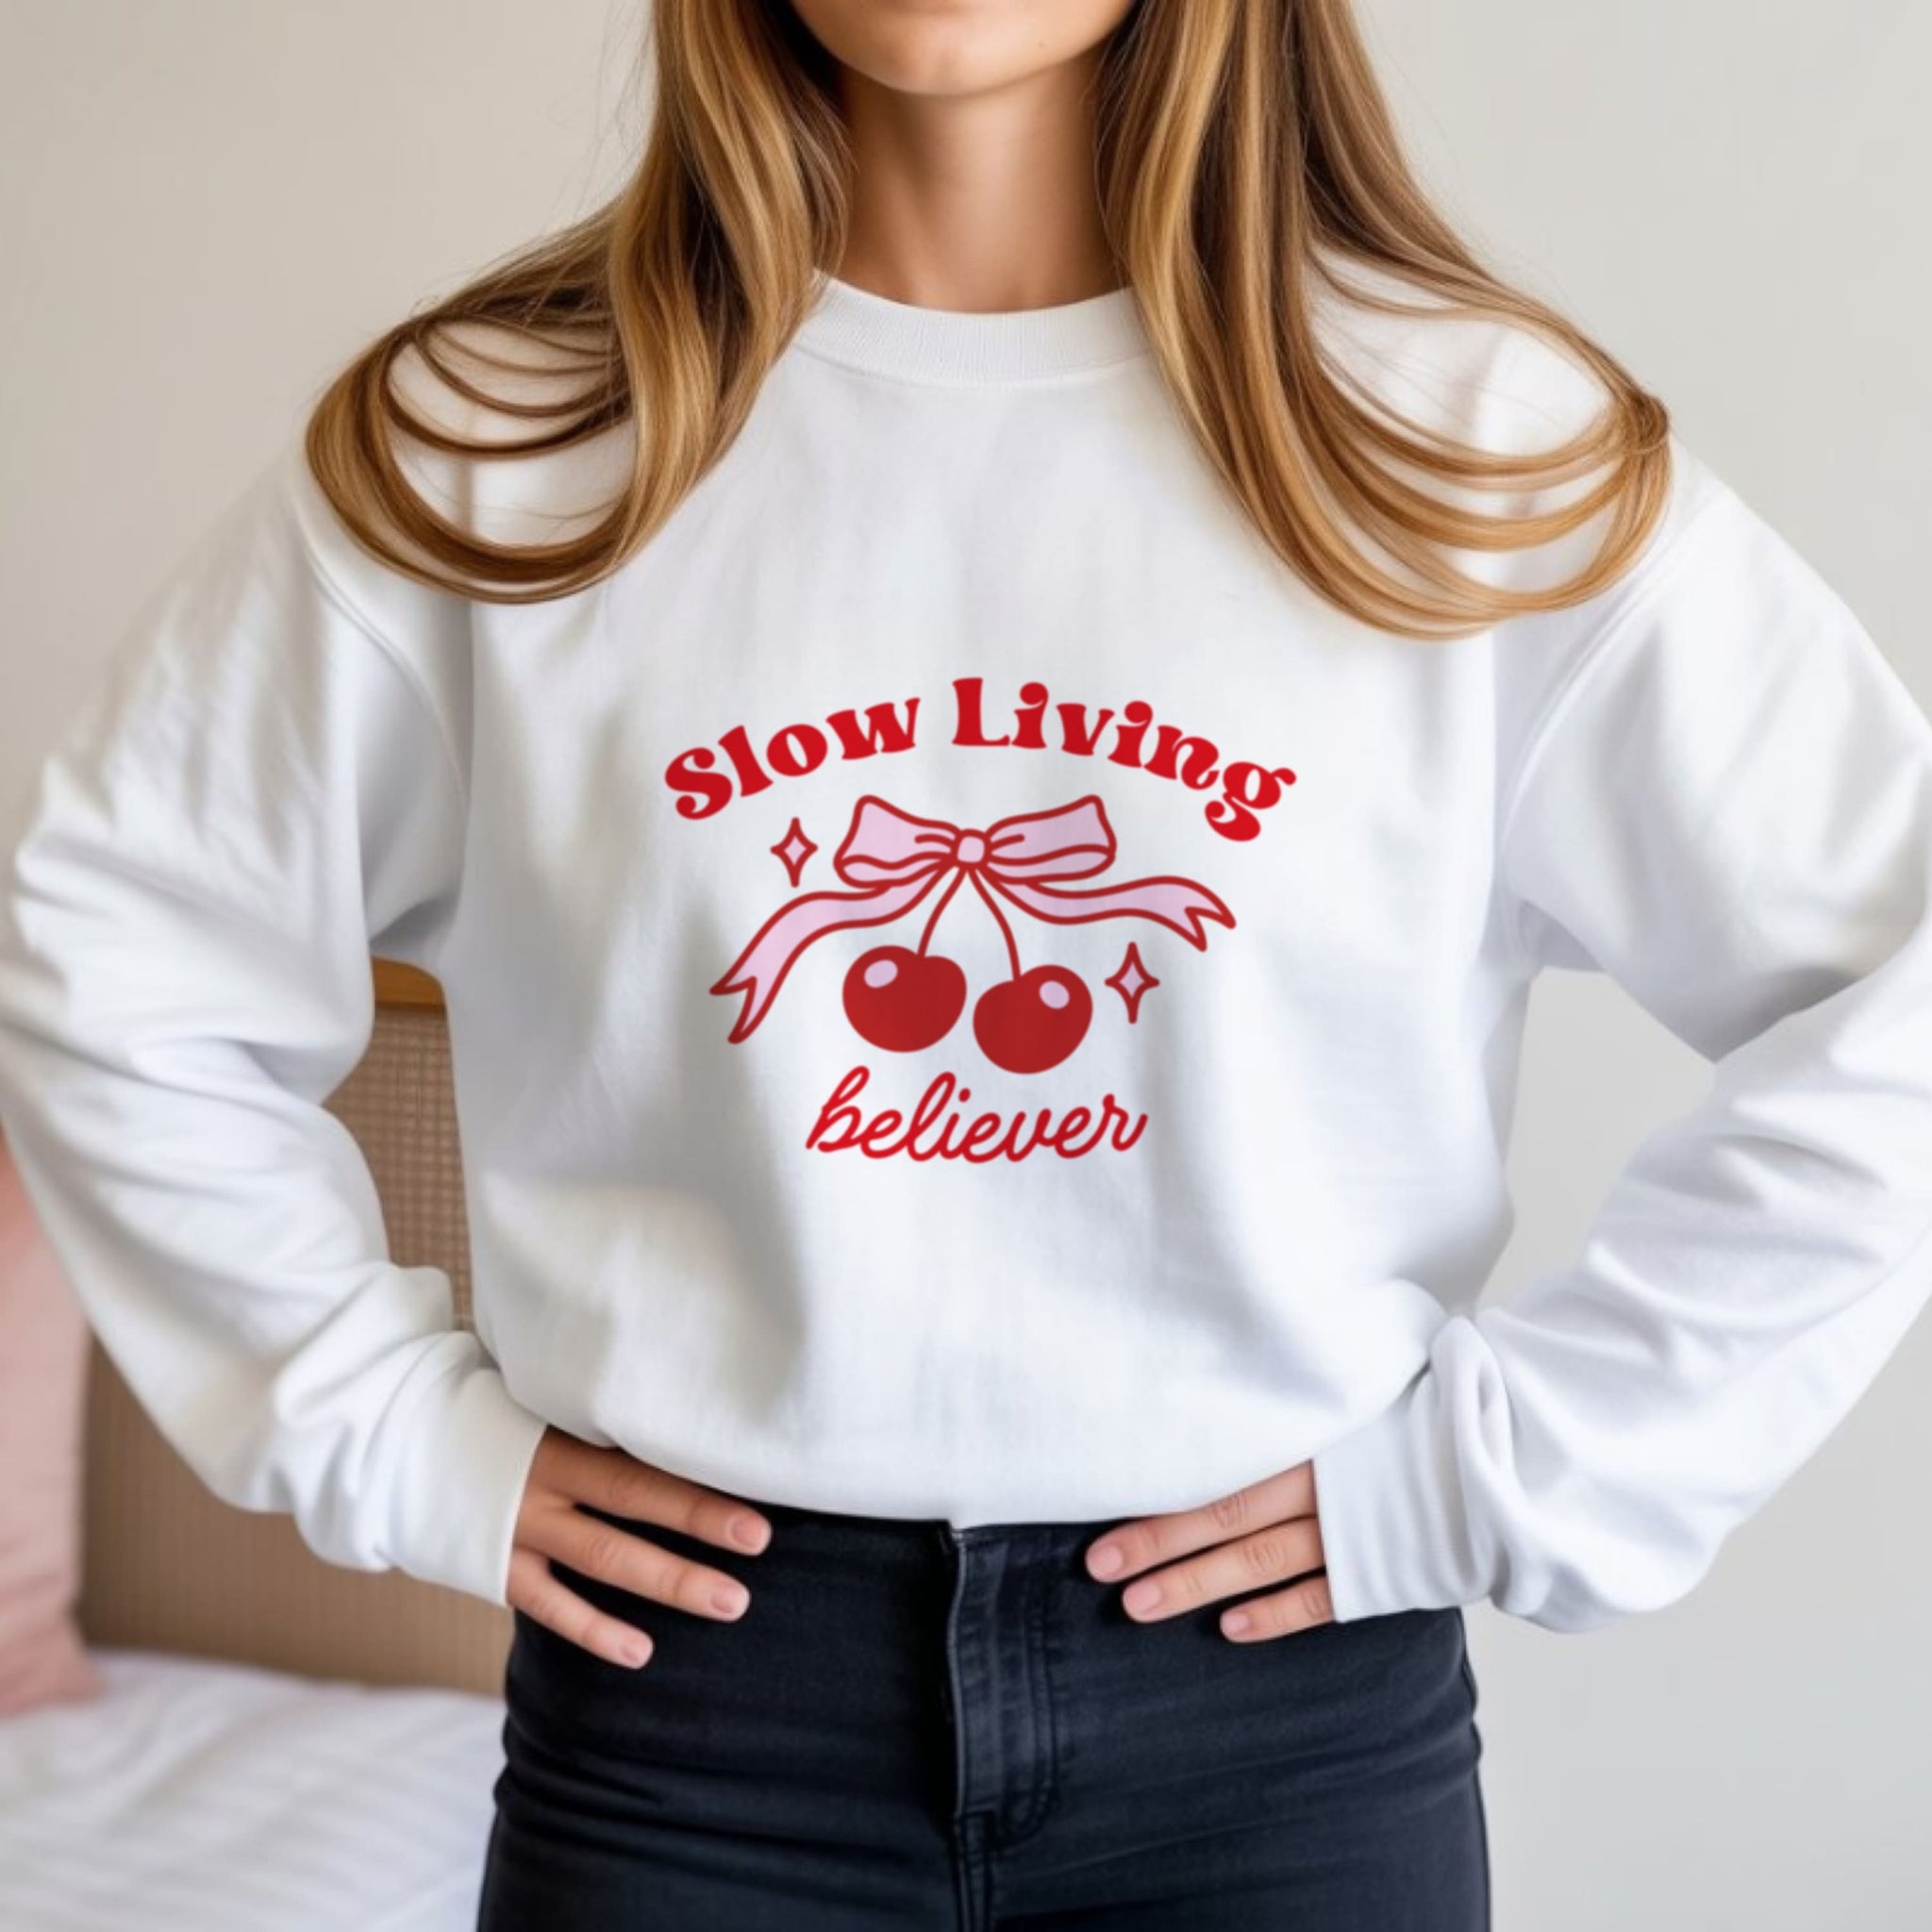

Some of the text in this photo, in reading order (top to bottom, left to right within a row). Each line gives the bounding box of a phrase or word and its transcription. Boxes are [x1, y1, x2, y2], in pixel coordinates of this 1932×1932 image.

[663, 677, 1297, 842] Slow Living
[805, 1065, 1149, 1164] believer
